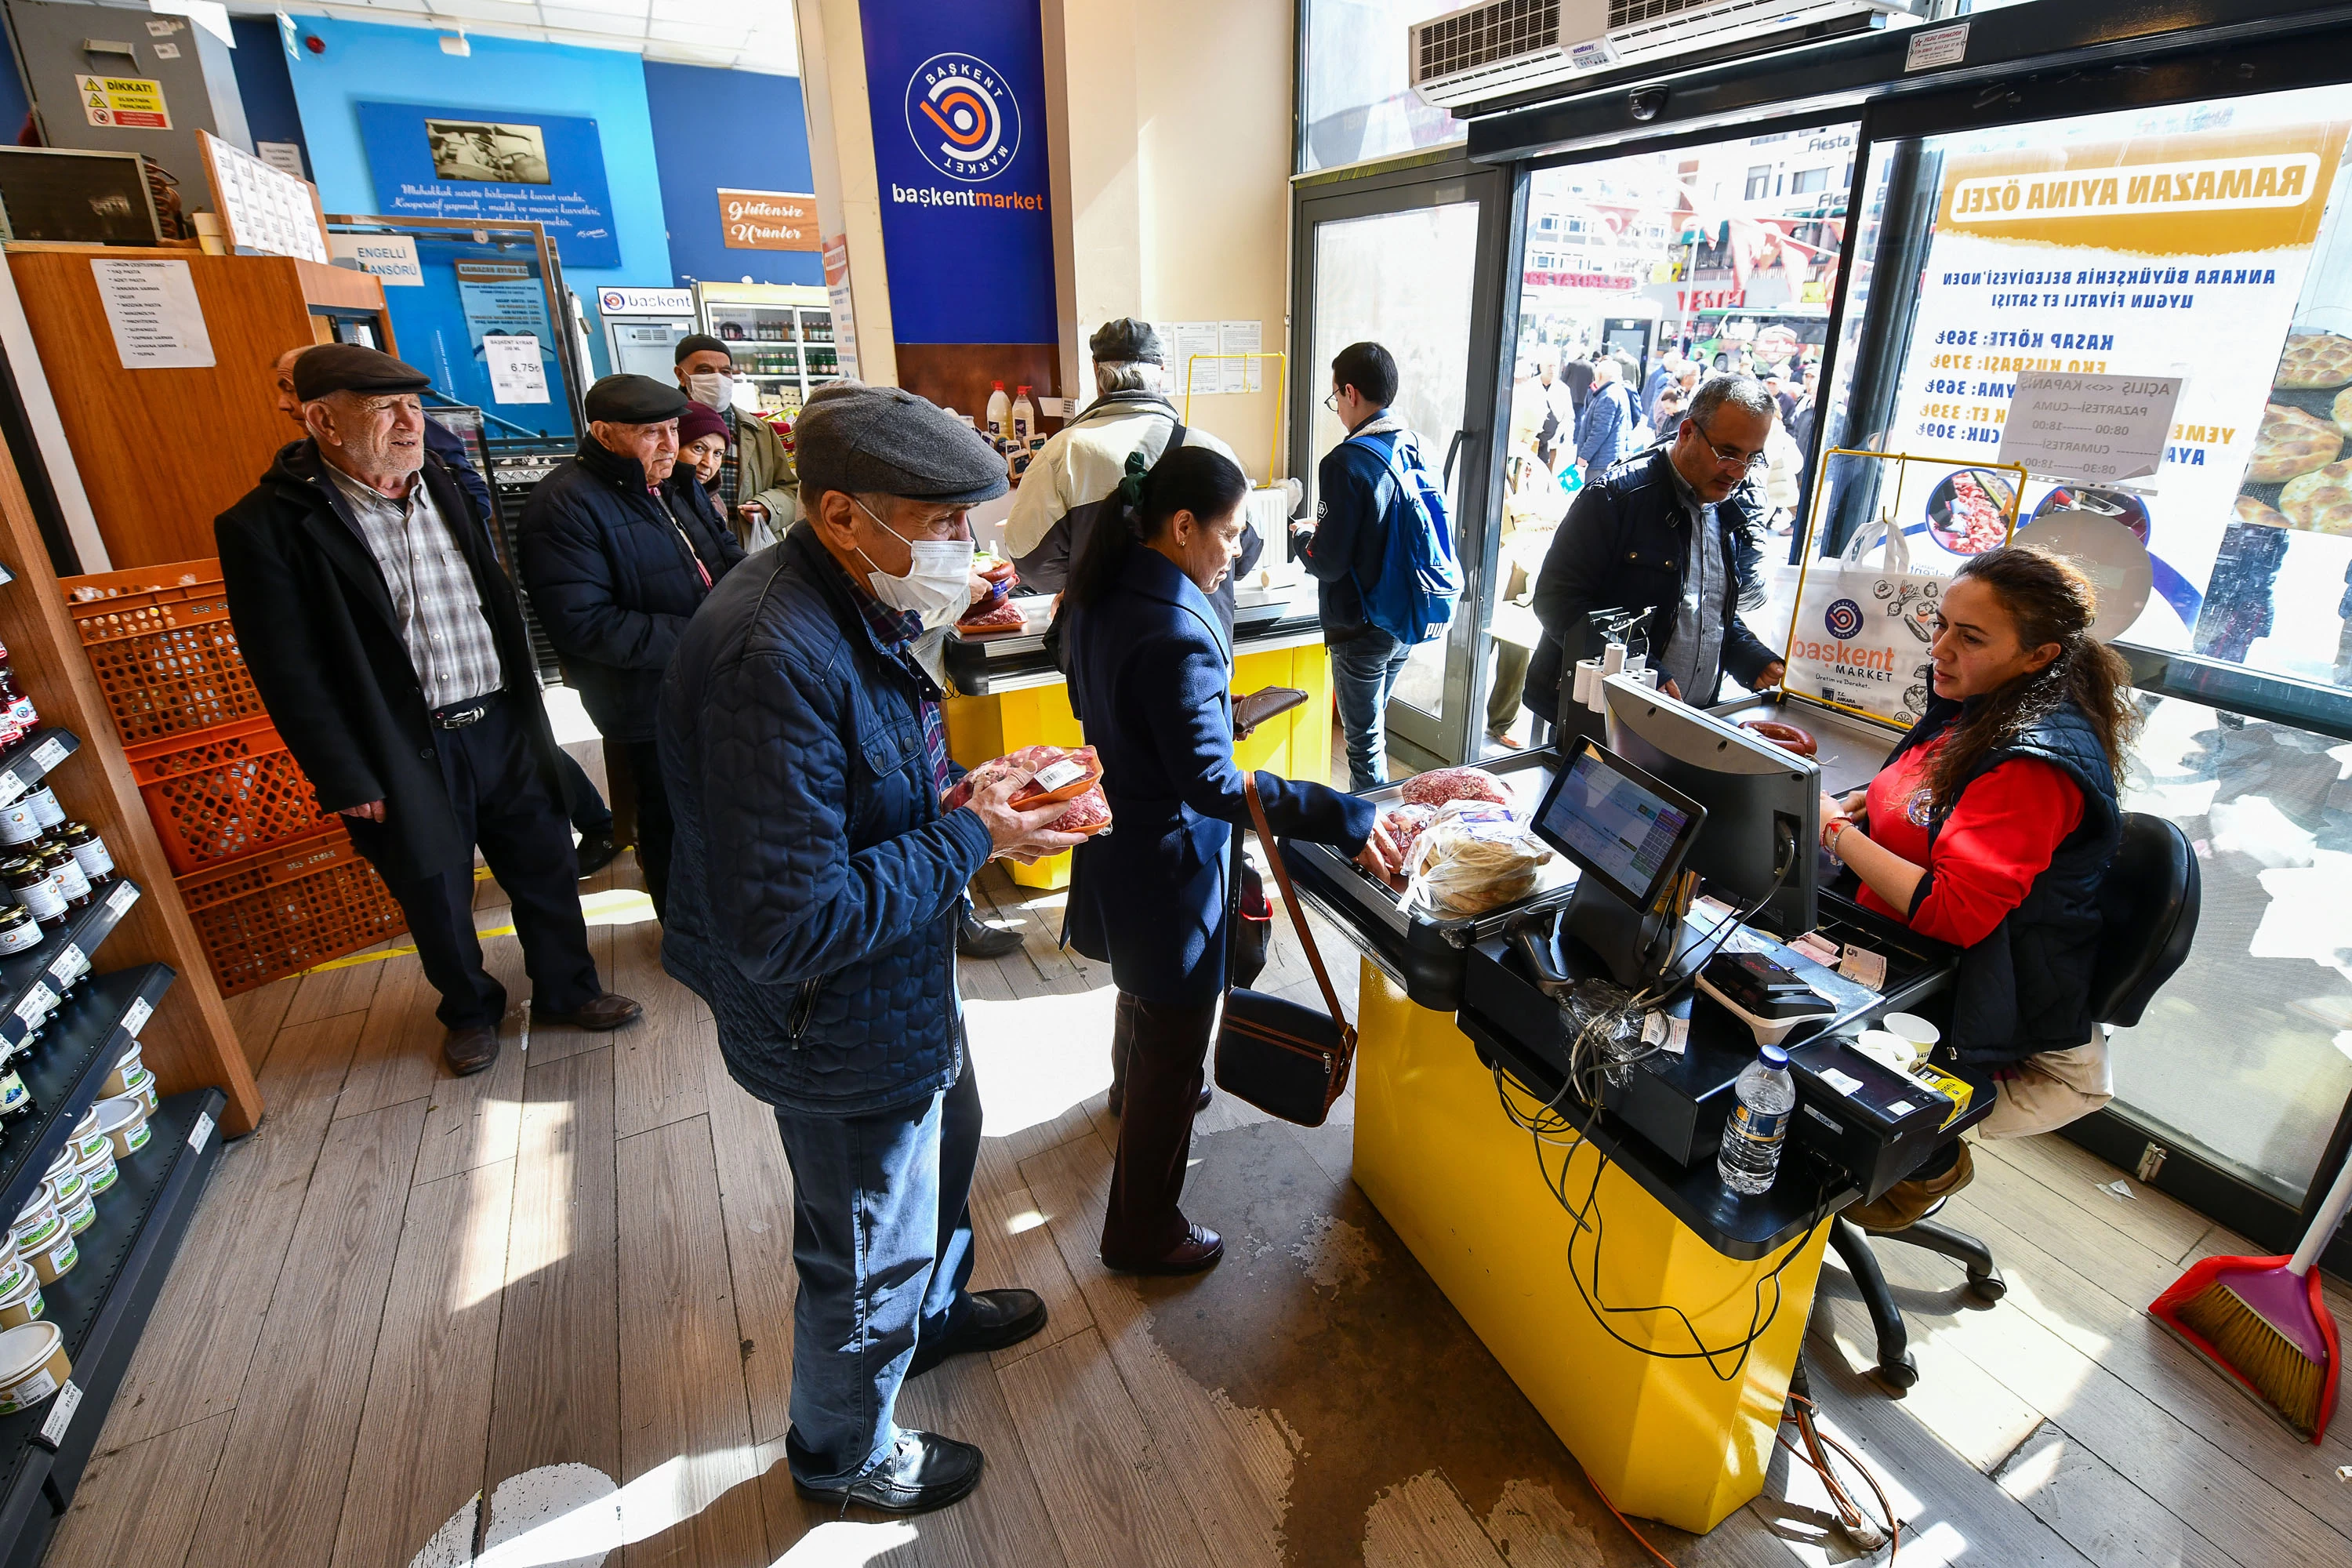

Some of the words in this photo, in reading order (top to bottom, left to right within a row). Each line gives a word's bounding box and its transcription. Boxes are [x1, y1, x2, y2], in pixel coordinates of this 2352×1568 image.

[107, 80, 153, 93] DİKKAT!
[924, 63, 1003, 99] BAŞKENT
[944, 145, 1009, 174] MARKET
[401, 183, 453, 196] Muhakkak
[530, 189, 556, 201] kuvvet
[1818, 193, 1849, 207] Fies
[390, 198, 444, 212] Kooperatif
[444, 200, 480, 212] yapmak
[528, 204, 559, 214] manevi
[728, 200, 804, 221] Glutensiz
[730, 222, 801, 245] Ürünler
[357, 246, 407, 259] ENGELLİ
[363, 262, 417, 276] ANSÖRÜ
[1423, 622, 1449, 639] PU
[1791, 634, 1895, 672] başkent
[1835, 665, 1893, 682] MARKET
[1846, 947, 1858, 957] 5
